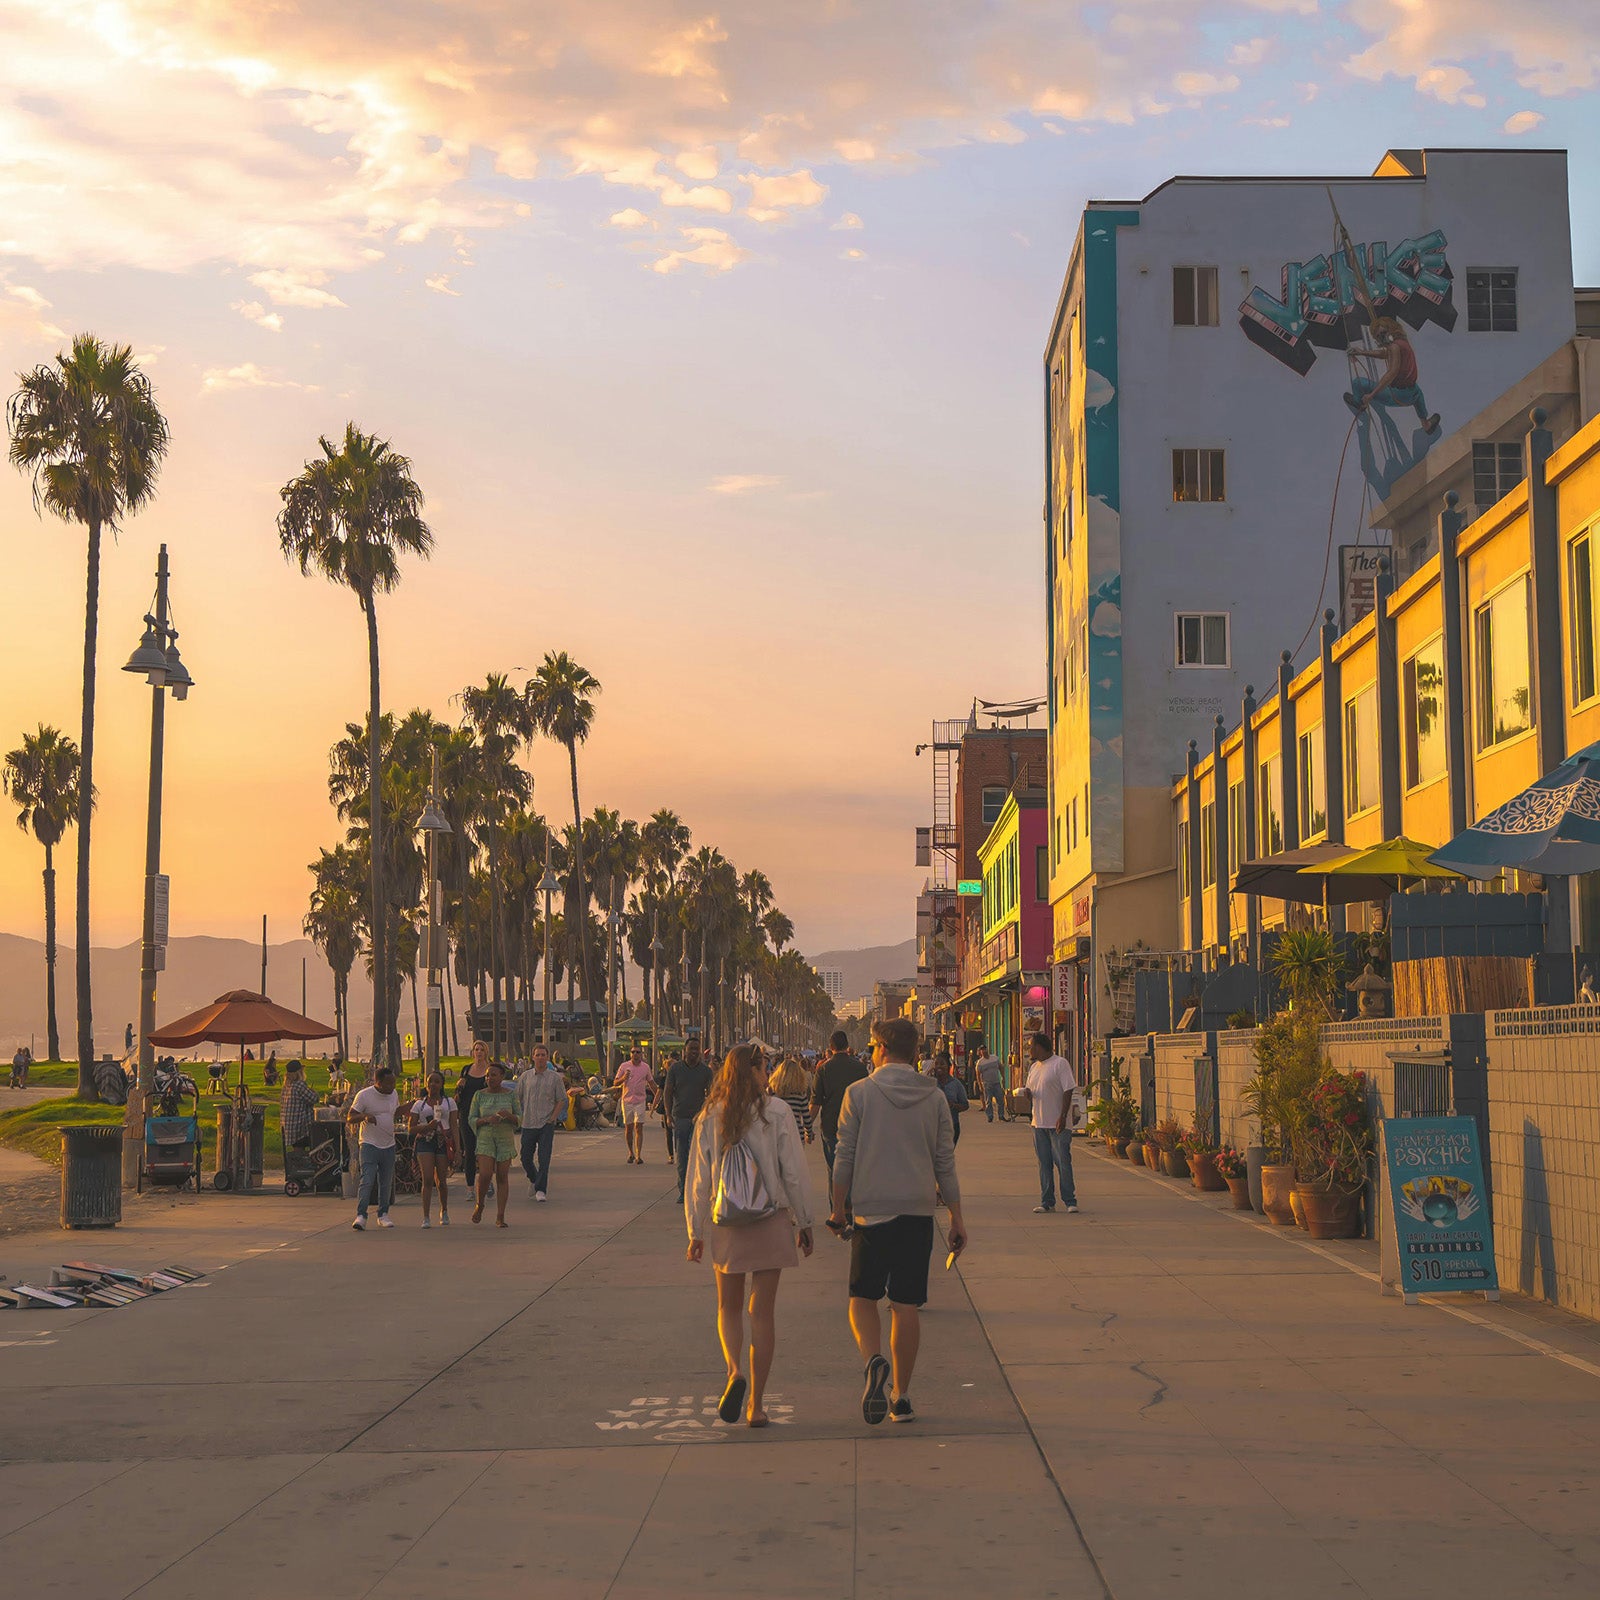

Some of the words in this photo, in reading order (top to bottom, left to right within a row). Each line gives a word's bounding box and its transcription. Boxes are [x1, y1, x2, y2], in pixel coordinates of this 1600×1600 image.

[1349, 551, 1377, 573] The
[1059, 966, 1068, 1008] MARKET
[1394, 1135, 1432, 1148] VENICE
[1435, 1133, 1469, 1147] BEACH
[1395, 1145, 1472, 1167] PSYCHIC
[1410, 1242, 1481, 1253] READINGS
[1411, 1259, 1441, 1282] $10
[1445, 1259, 1481, 1269] SPECIAL
